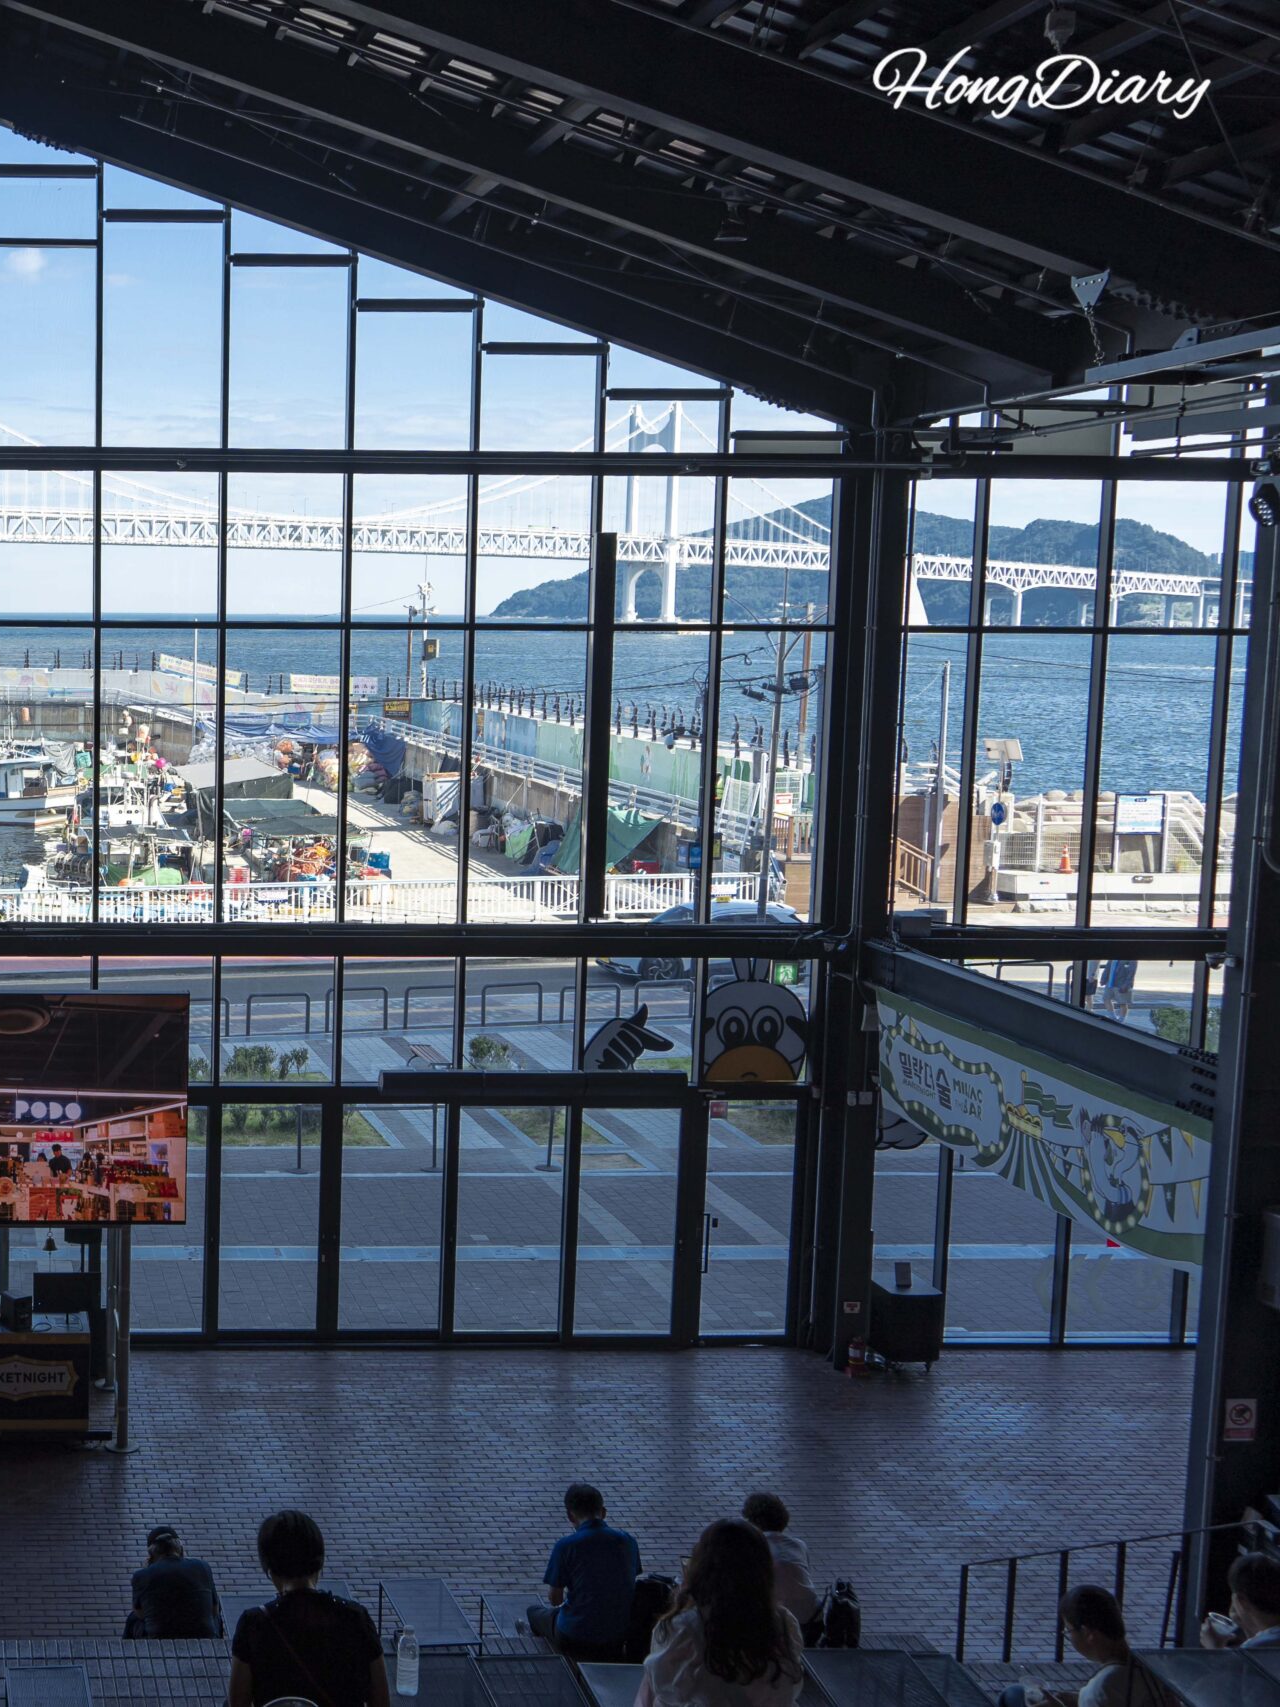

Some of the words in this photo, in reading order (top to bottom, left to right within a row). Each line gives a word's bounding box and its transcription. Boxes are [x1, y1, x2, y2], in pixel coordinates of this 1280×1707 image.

[952, 1078, 983, 1103] MILLAC
[15, 1100, 82, 1120] PODO
[963, 1099, 983, 1120] BAR
